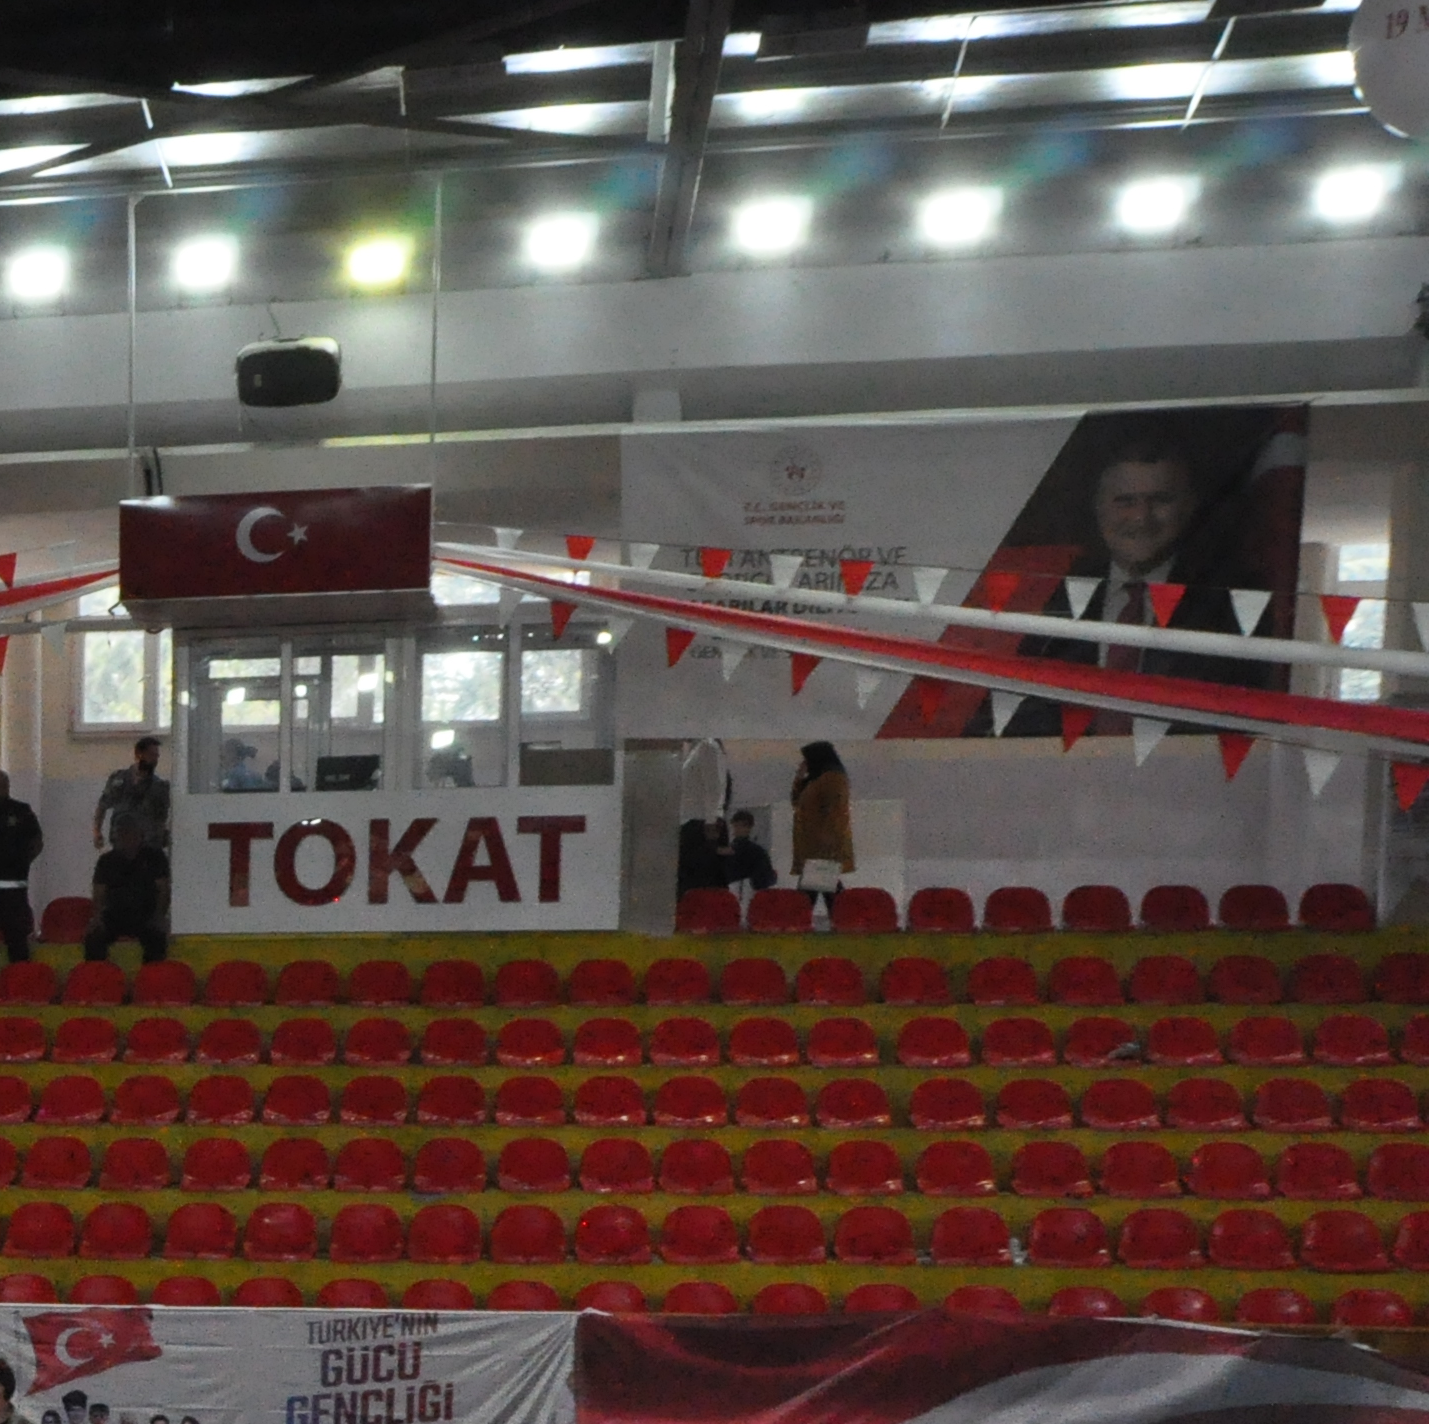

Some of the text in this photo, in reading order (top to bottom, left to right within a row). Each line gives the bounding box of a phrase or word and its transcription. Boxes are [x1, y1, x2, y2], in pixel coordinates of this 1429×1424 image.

[877, 546, 907, 566] VE
[208, 815, 587, 907] TOKAT
[321, 1341, 422, 1388] GÜCÜ
